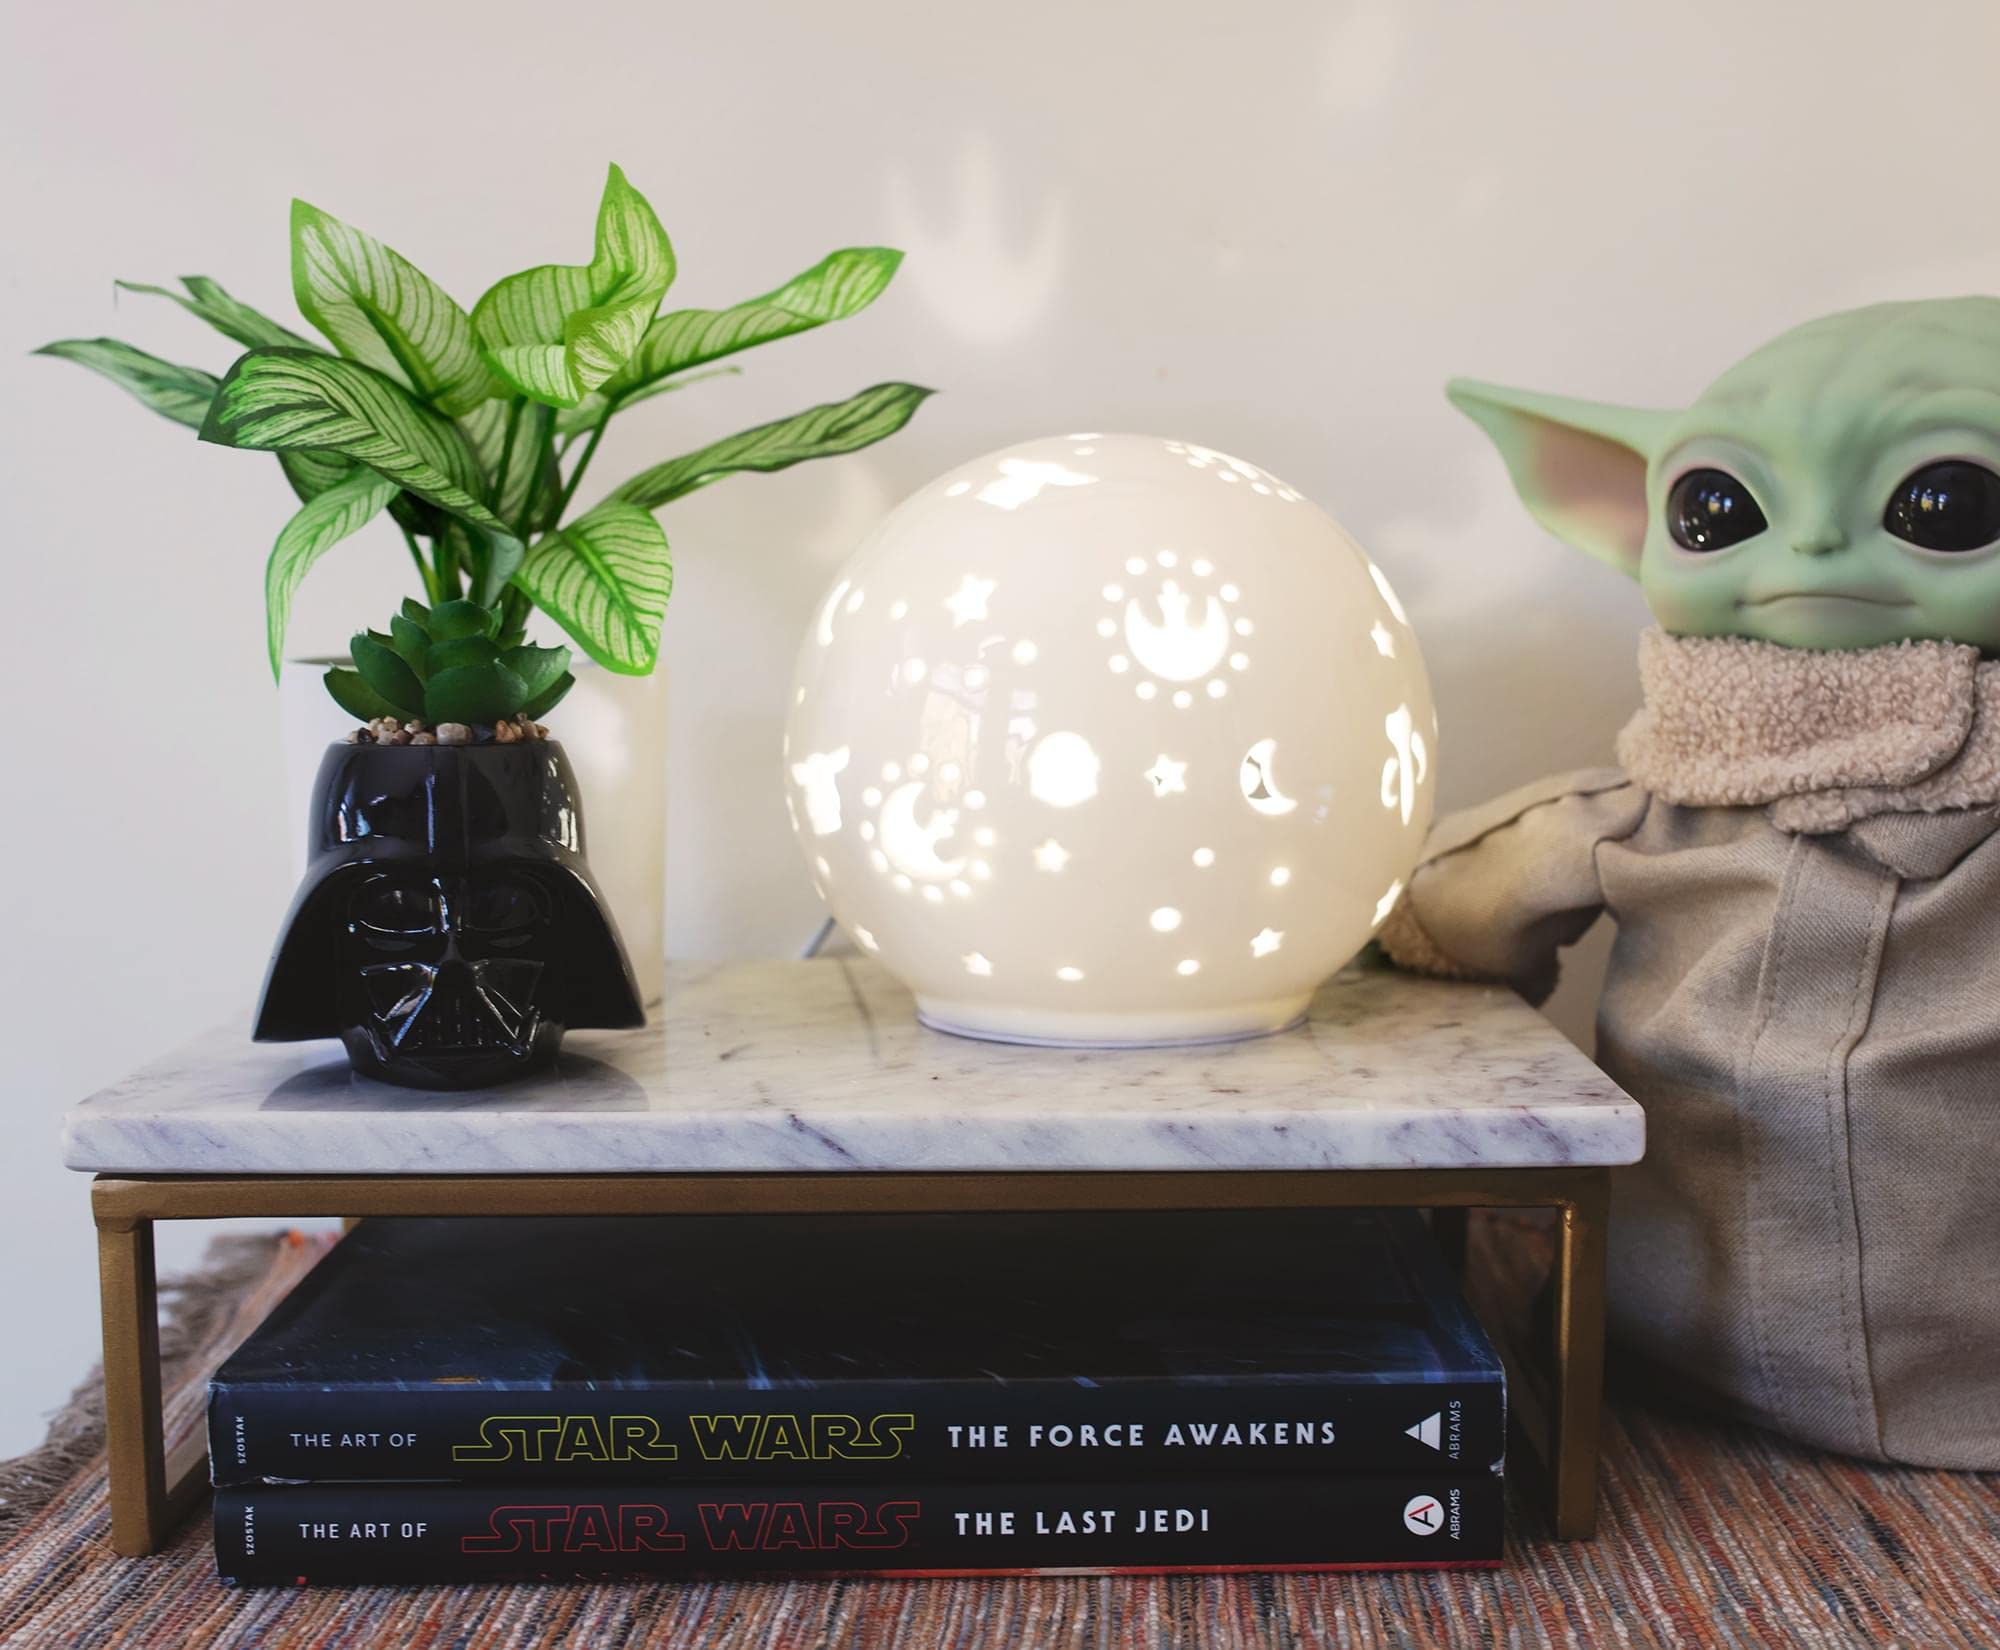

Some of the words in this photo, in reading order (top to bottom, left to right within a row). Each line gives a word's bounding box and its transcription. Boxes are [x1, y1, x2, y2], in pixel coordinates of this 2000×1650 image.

[235, 1415, 246, 1465] SZOSTAK
[290, 1433, 331, 1447] THE
[340, 1433, 381, 1447] ART
[389, 1433, 417, 1447] OF
[452, 1415, 678, 1462] STAR
[689, 1414, 915, 1460] WARS
[948, 1426, 1008, 1448] THE
[1029, 1424, 1145, 1447] FORCE
[1163, 1422, 1336, 1446] AWAKENS
[1449, 1400, 1462, 1460] ABRAMS
[244, 1505, 256, 1556] SZOSTAK
[299, 1524, 339, 1538] THE
[350, 1523, 391, 1538] ART
[401, 1523, 428, 1538] OF
[461, 1505, 686, 1553] STAR
[698, 1501, 921, 1551] WARS
[954, 1513, 1015, 1536] THE
[1036, 1510, 1116, 1534] LAST
[1135, 1509, 1209, 1533] JEDI
[1450, 1488, 1461, 1541] ABRAMS
